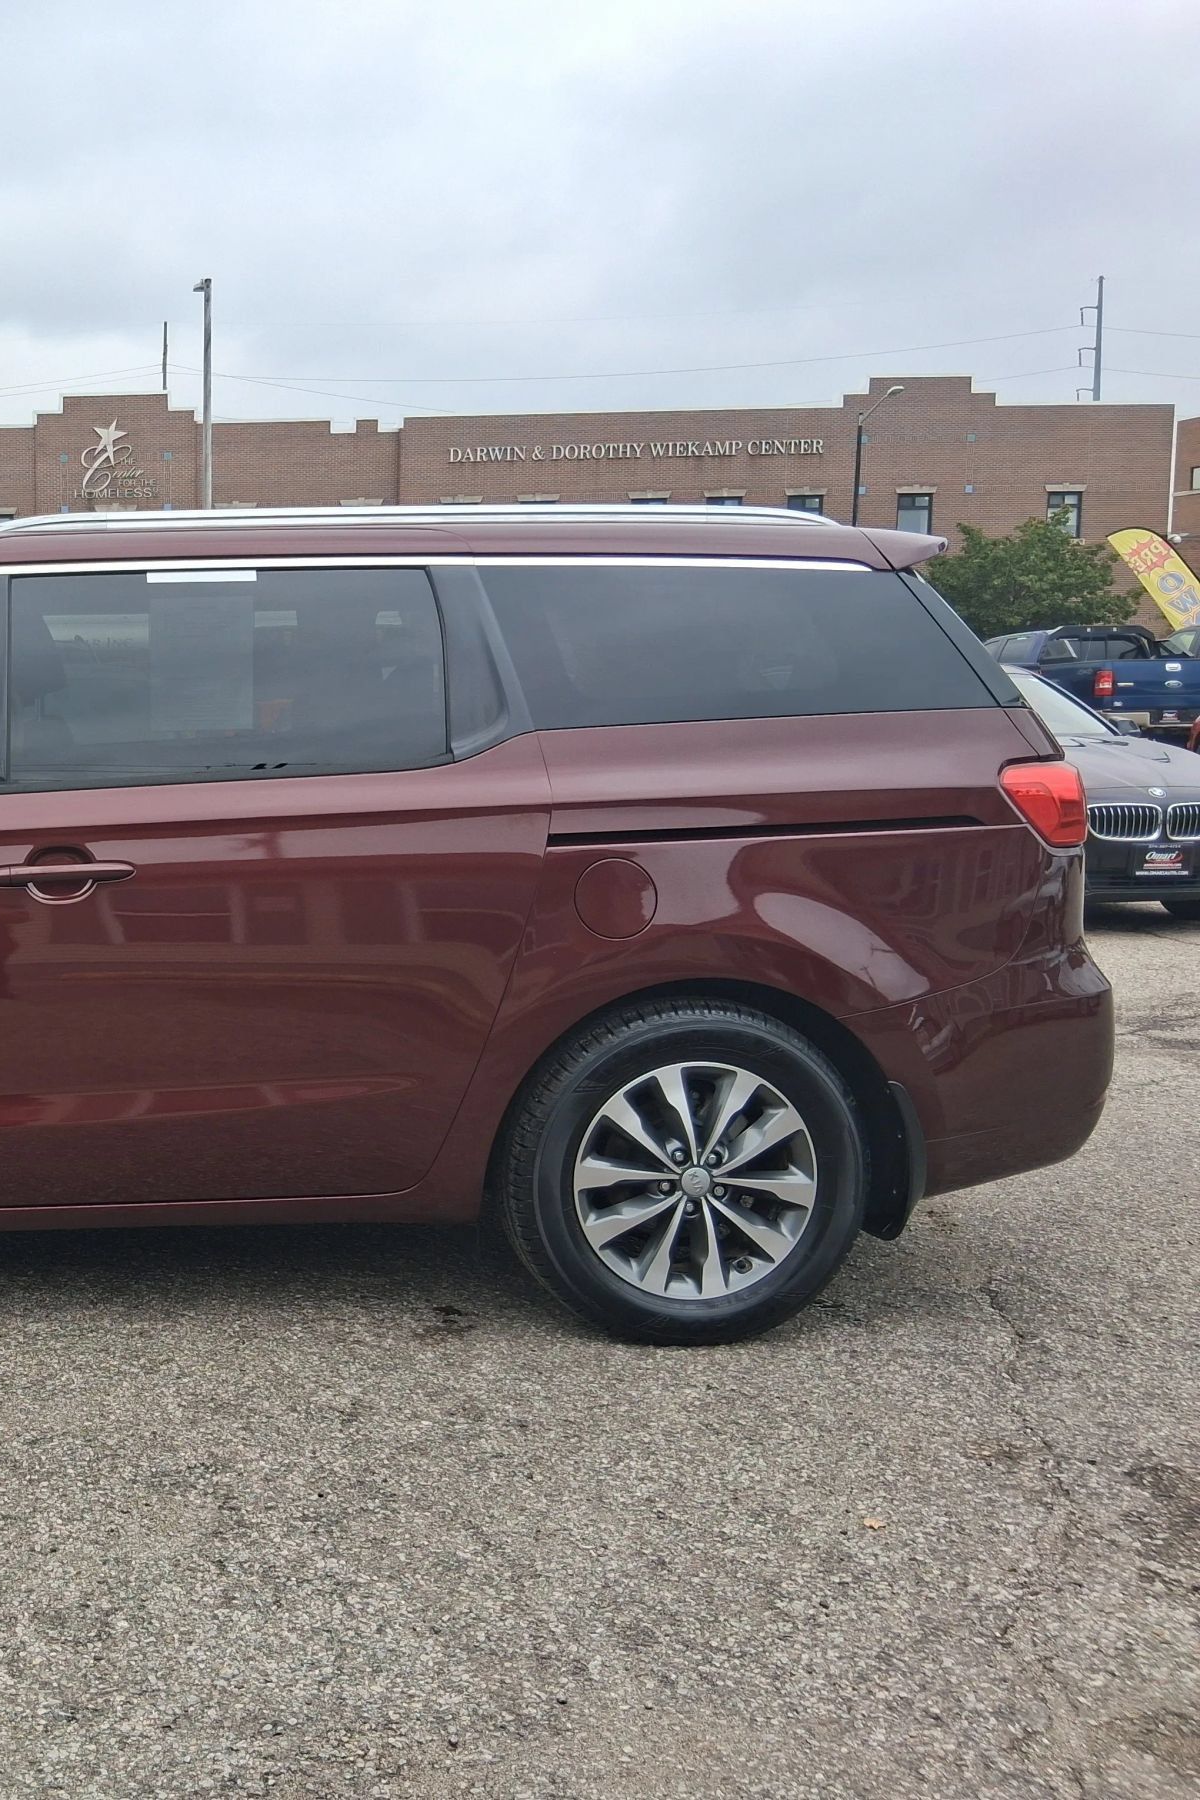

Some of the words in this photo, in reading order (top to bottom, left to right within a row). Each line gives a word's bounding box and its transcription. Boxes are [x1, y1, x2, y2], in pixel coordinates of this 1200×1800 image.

[449, 446, 527, 462] DARWIN
[532, 445, 545, 461] &
[552, 442, 644, 460] DOROTHY
[649, 440, 742, 457] WIEKAMP
[747, 439, 824, 456] CENTER
[140, 479, 157, 487] THE
[74, 487, 152, 499] HOMELESS
[1145, 851, 1179, 861] Omari
